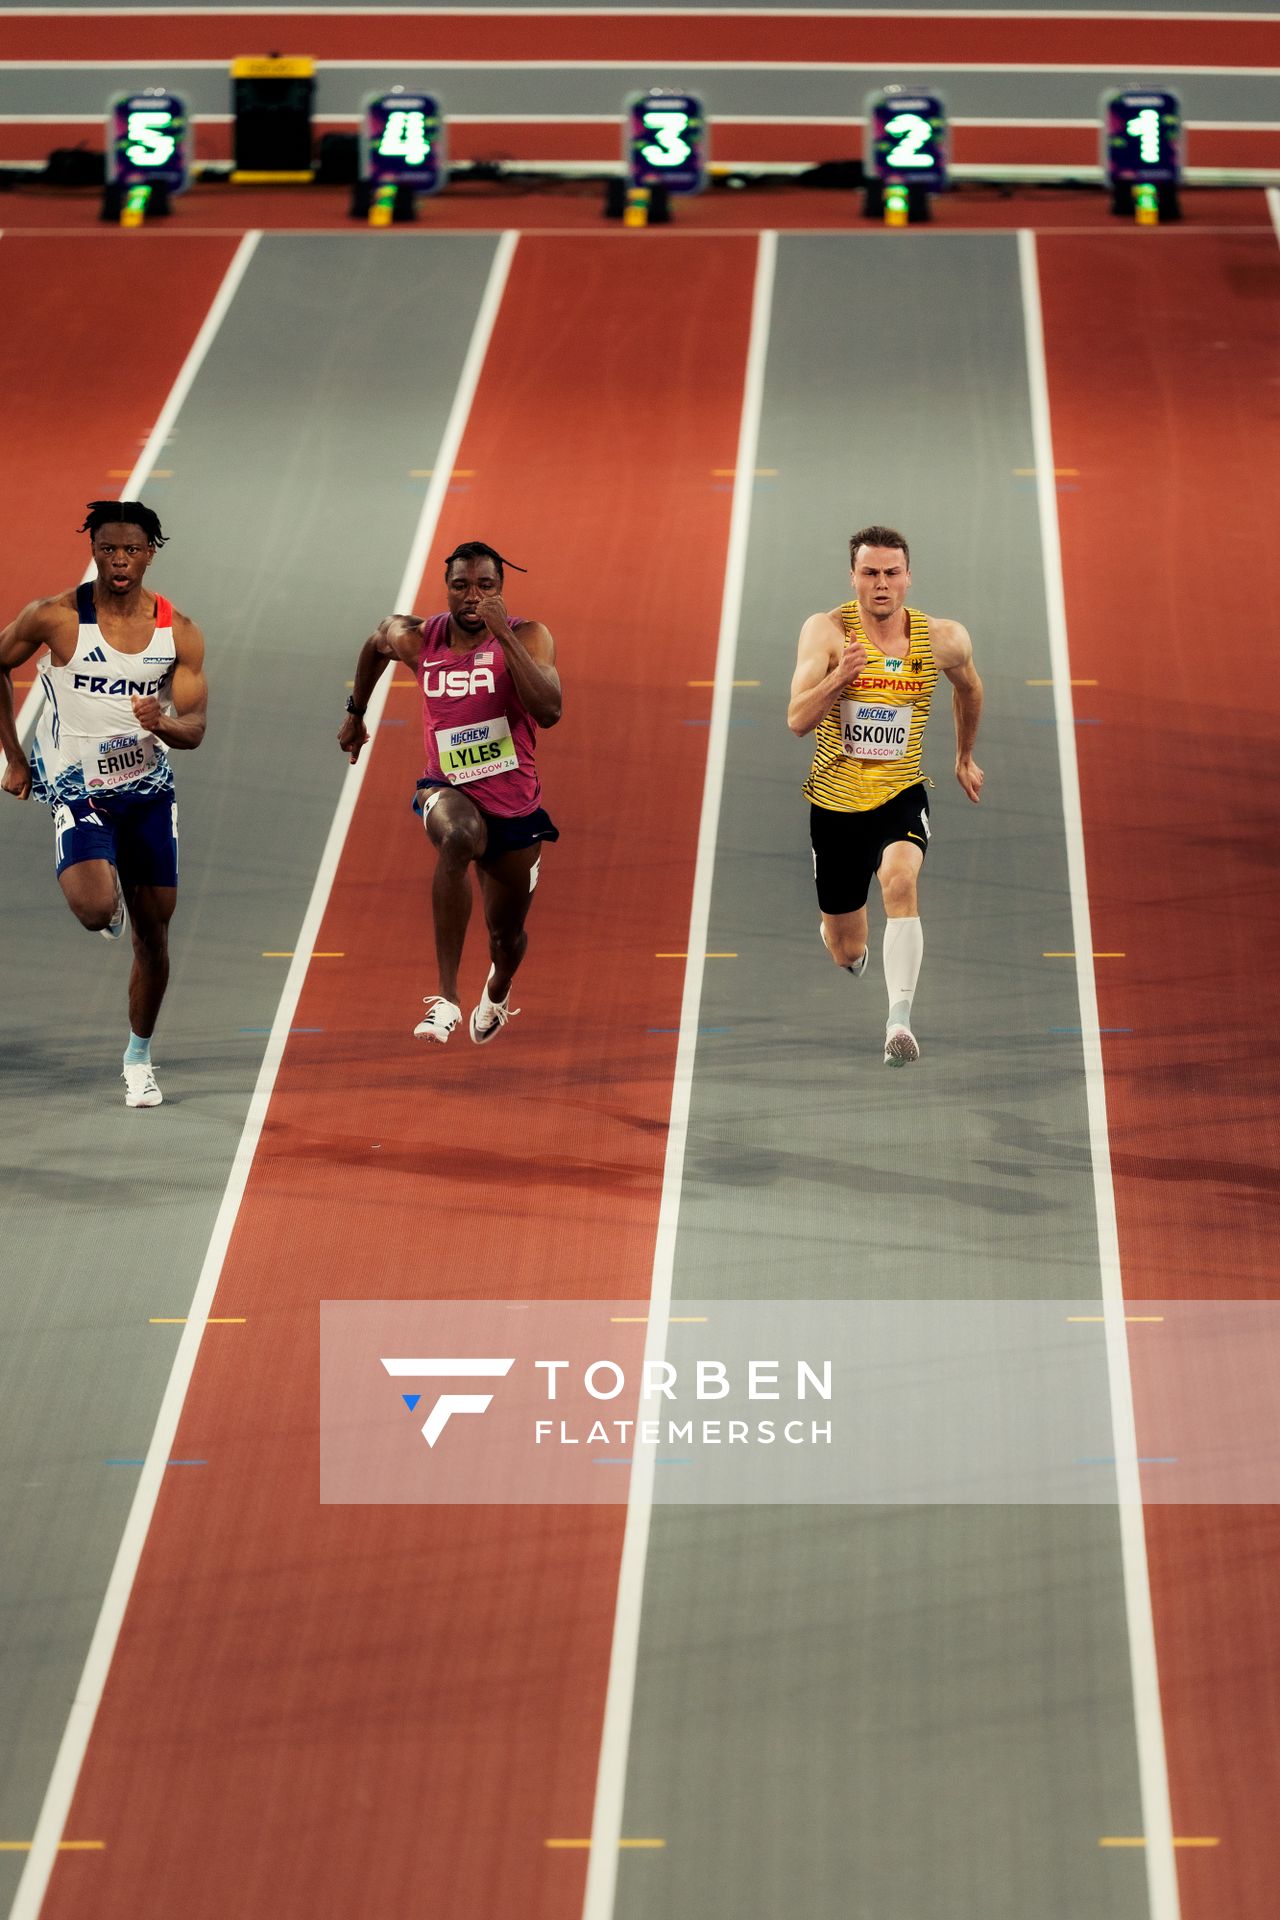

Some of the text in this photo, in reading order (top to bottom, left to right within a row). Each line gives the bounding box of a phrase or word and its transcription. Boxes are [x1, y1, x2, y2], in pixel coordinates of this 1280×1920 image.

[126, 112, 175, 166] 5
[378, 112, 430, 165] 4
[641, 112, 691, 166] 3
[885, 113, 934, 168] 2
[1127, 109, 1160, 164] 1
[423, 668, 495, 698] USA
[850, 677, 924, 692] GERMANY
[857, 706, 897, 721] HI-CHEW
[450, 726, 489, 746] HI-CHEW
[844, 725, 905, 744] ASKOVIC
[97, 748, 145, 775] ERIUS
[449, 742, 502, 769] LYLES
[856, 746, 895, 757] GLASGOW
[107, 767, 146, 786] GLASGOW
[459, 759, 515, 780] GLASGOW 24
